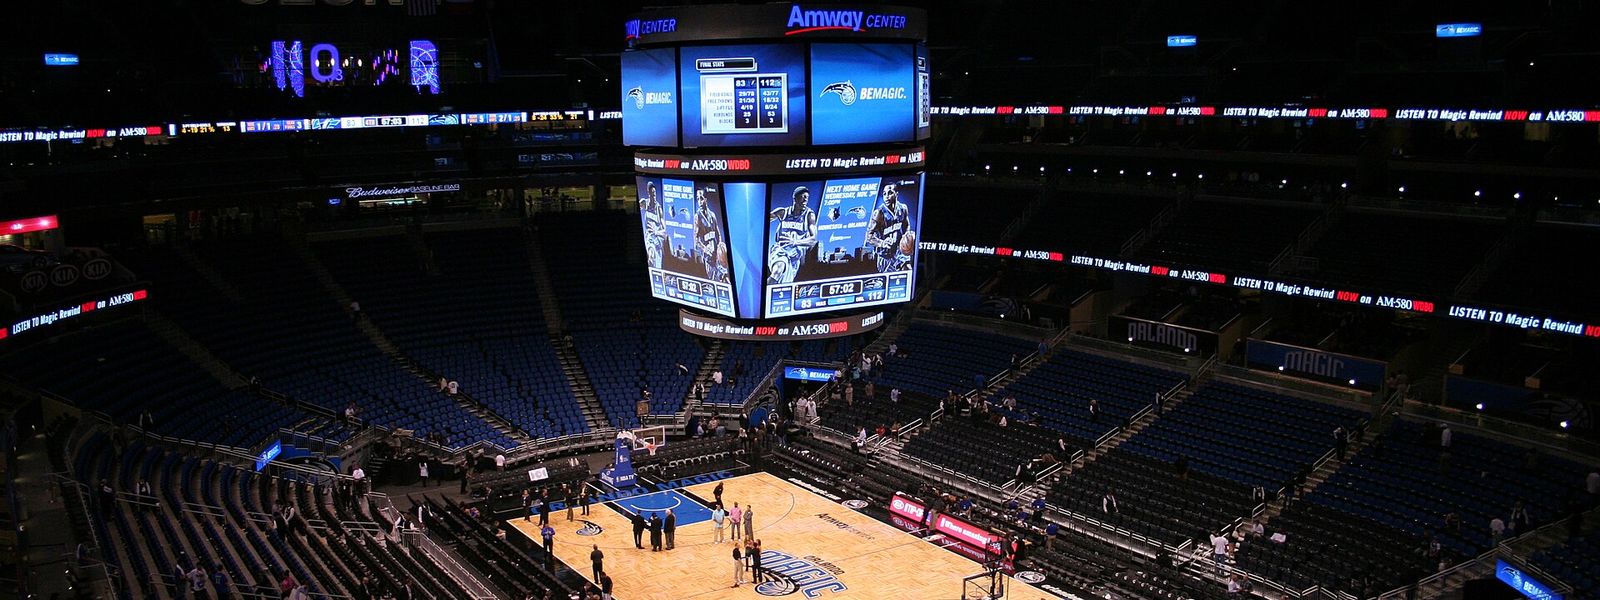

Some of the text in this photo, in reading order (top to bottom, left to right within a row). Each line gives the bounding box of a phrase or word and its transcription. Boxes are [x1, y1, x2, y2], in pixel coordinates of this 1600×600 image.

[787, 5, 906, 32] Amway CENTER
[641, 18, 676, 35] CENTER
[735, 79, 746, 87] 83
[950, 107, 970, 115] Magic
[1104, 107, 1123, 116] Magic
[1224, 108, 1247, 116] LISTEN
[1249, 108, 1257, 116] TO
[1258, 108, 1279, 118] Magic
[1281, 108, 1307, 117] Rewind
[1309, 109, 1327, 117] NOW
[1396, 109, 1425, 119] LISTEN
[1427, 110, 1439, 119] TO
[1440, 110, 1467, 121] Magic
[1469, 110, 1502, 120] Rewind
[1504, 111, 1527, 120] NOW
[1529, 112, 1542, 120] on
[24, 132, 34, 140] TO
[35, 131, 58, 143] Magic
[59, 130, 85, 141] Rewind
[665, 160, 680, 168] NOW
[727, 160, 750, 170] WDBO
[786, 159, 817, 168] LISTEN
[820, 159, 831, 167] TO
[833, 158, 858, 168] Magic
[860, 156, 884, 165] Rewind
[345, 184, 410, 197] Budweiser
[826, 183, 878, 194] NEXT HOME GAME
[948, 244, 968, 253] Magic
[971, 246, 994, 254] Rewind
[1072, 256, 1093, 265] LISTEN
[1095, 259, 1103, 267] TO
[1104, 260, 1124, 270] Magic
[1126, 263, 1150, 273] Rewind
[1152, 266, 1168, 275] NOW
[829, 283, 855, 295] 57:02
[1234, 277, 1261, 288] LISTEN
[1264, 281, 1274, 290] TO
[1276, 283, 1301, 295] Magic
[1303, 287, 1334, 298] Rewind
[1337, 291, 1359, 301] NOW
[1360, 296, 1371, 304] on
[800, 299, 812, 309] 83
[868, 291, 882, 301] 112
[13, 320, 30, 334] LISTEN
[32, 317, 39, 327] TO
[40, 312, 58, 324] Magic
[60, 305, 80, 319] Rewind
[1449, 306, 1486, 319] LISTEN
[1490, 311, 1503, 322] TO
[1506, 314, 1540, 328] Magic
[1543, 319, 1583, 334] Rewind
[696, 321, 703, 329] TO
[703, 319, 723, 336] Magic
[725, 325, 753, 334] Rewind
[756, 327, 776, 335] NOW
[829, 322, 848, 333] WDBO
[1128, 321, 1197, 352] ORLANDO
[760, 549, 848, 600] MAGIC
